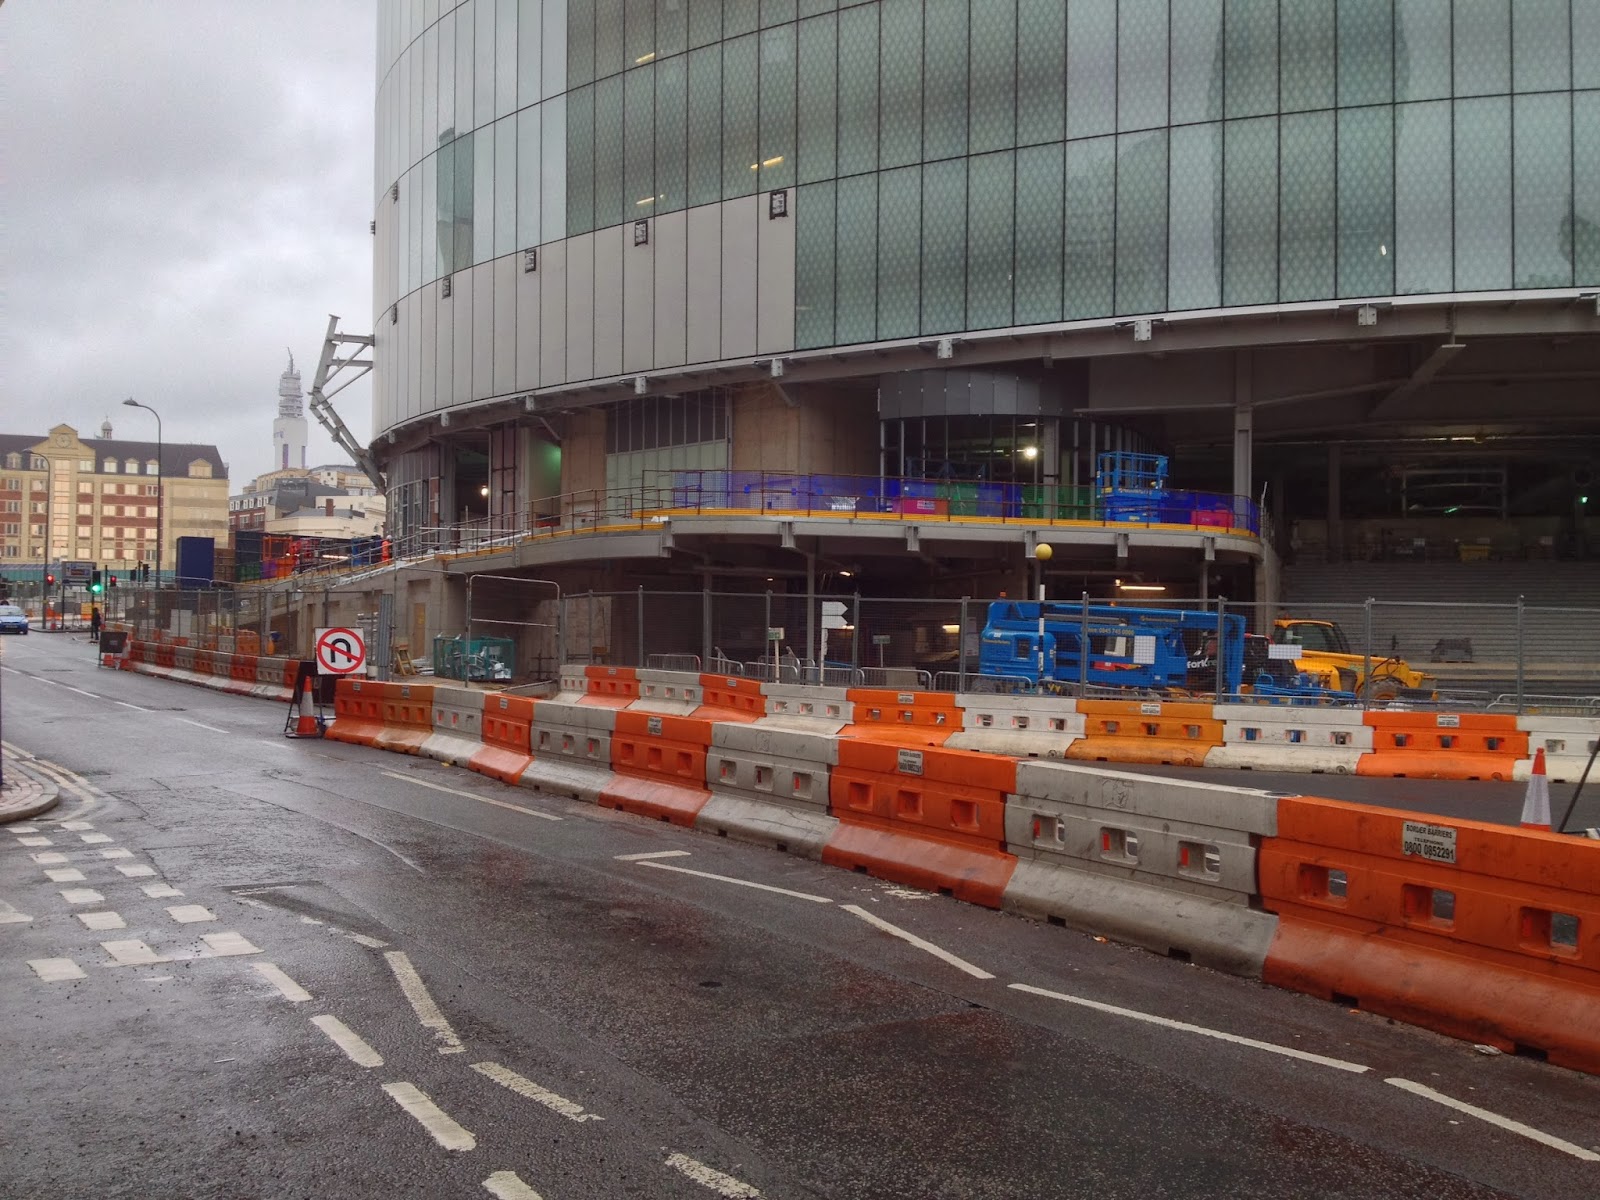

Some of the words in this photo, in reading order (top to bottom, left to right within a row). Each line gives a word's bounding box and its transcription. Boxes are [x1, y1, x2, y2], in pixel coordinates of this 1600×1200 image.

[1406, 825, 1426, 834] BORDER
[1428, 829, 1452, 838] BARRIERS
[1405, 841, 1421, 854] 0800
[1424, 844, 1454, 860] 0852291
